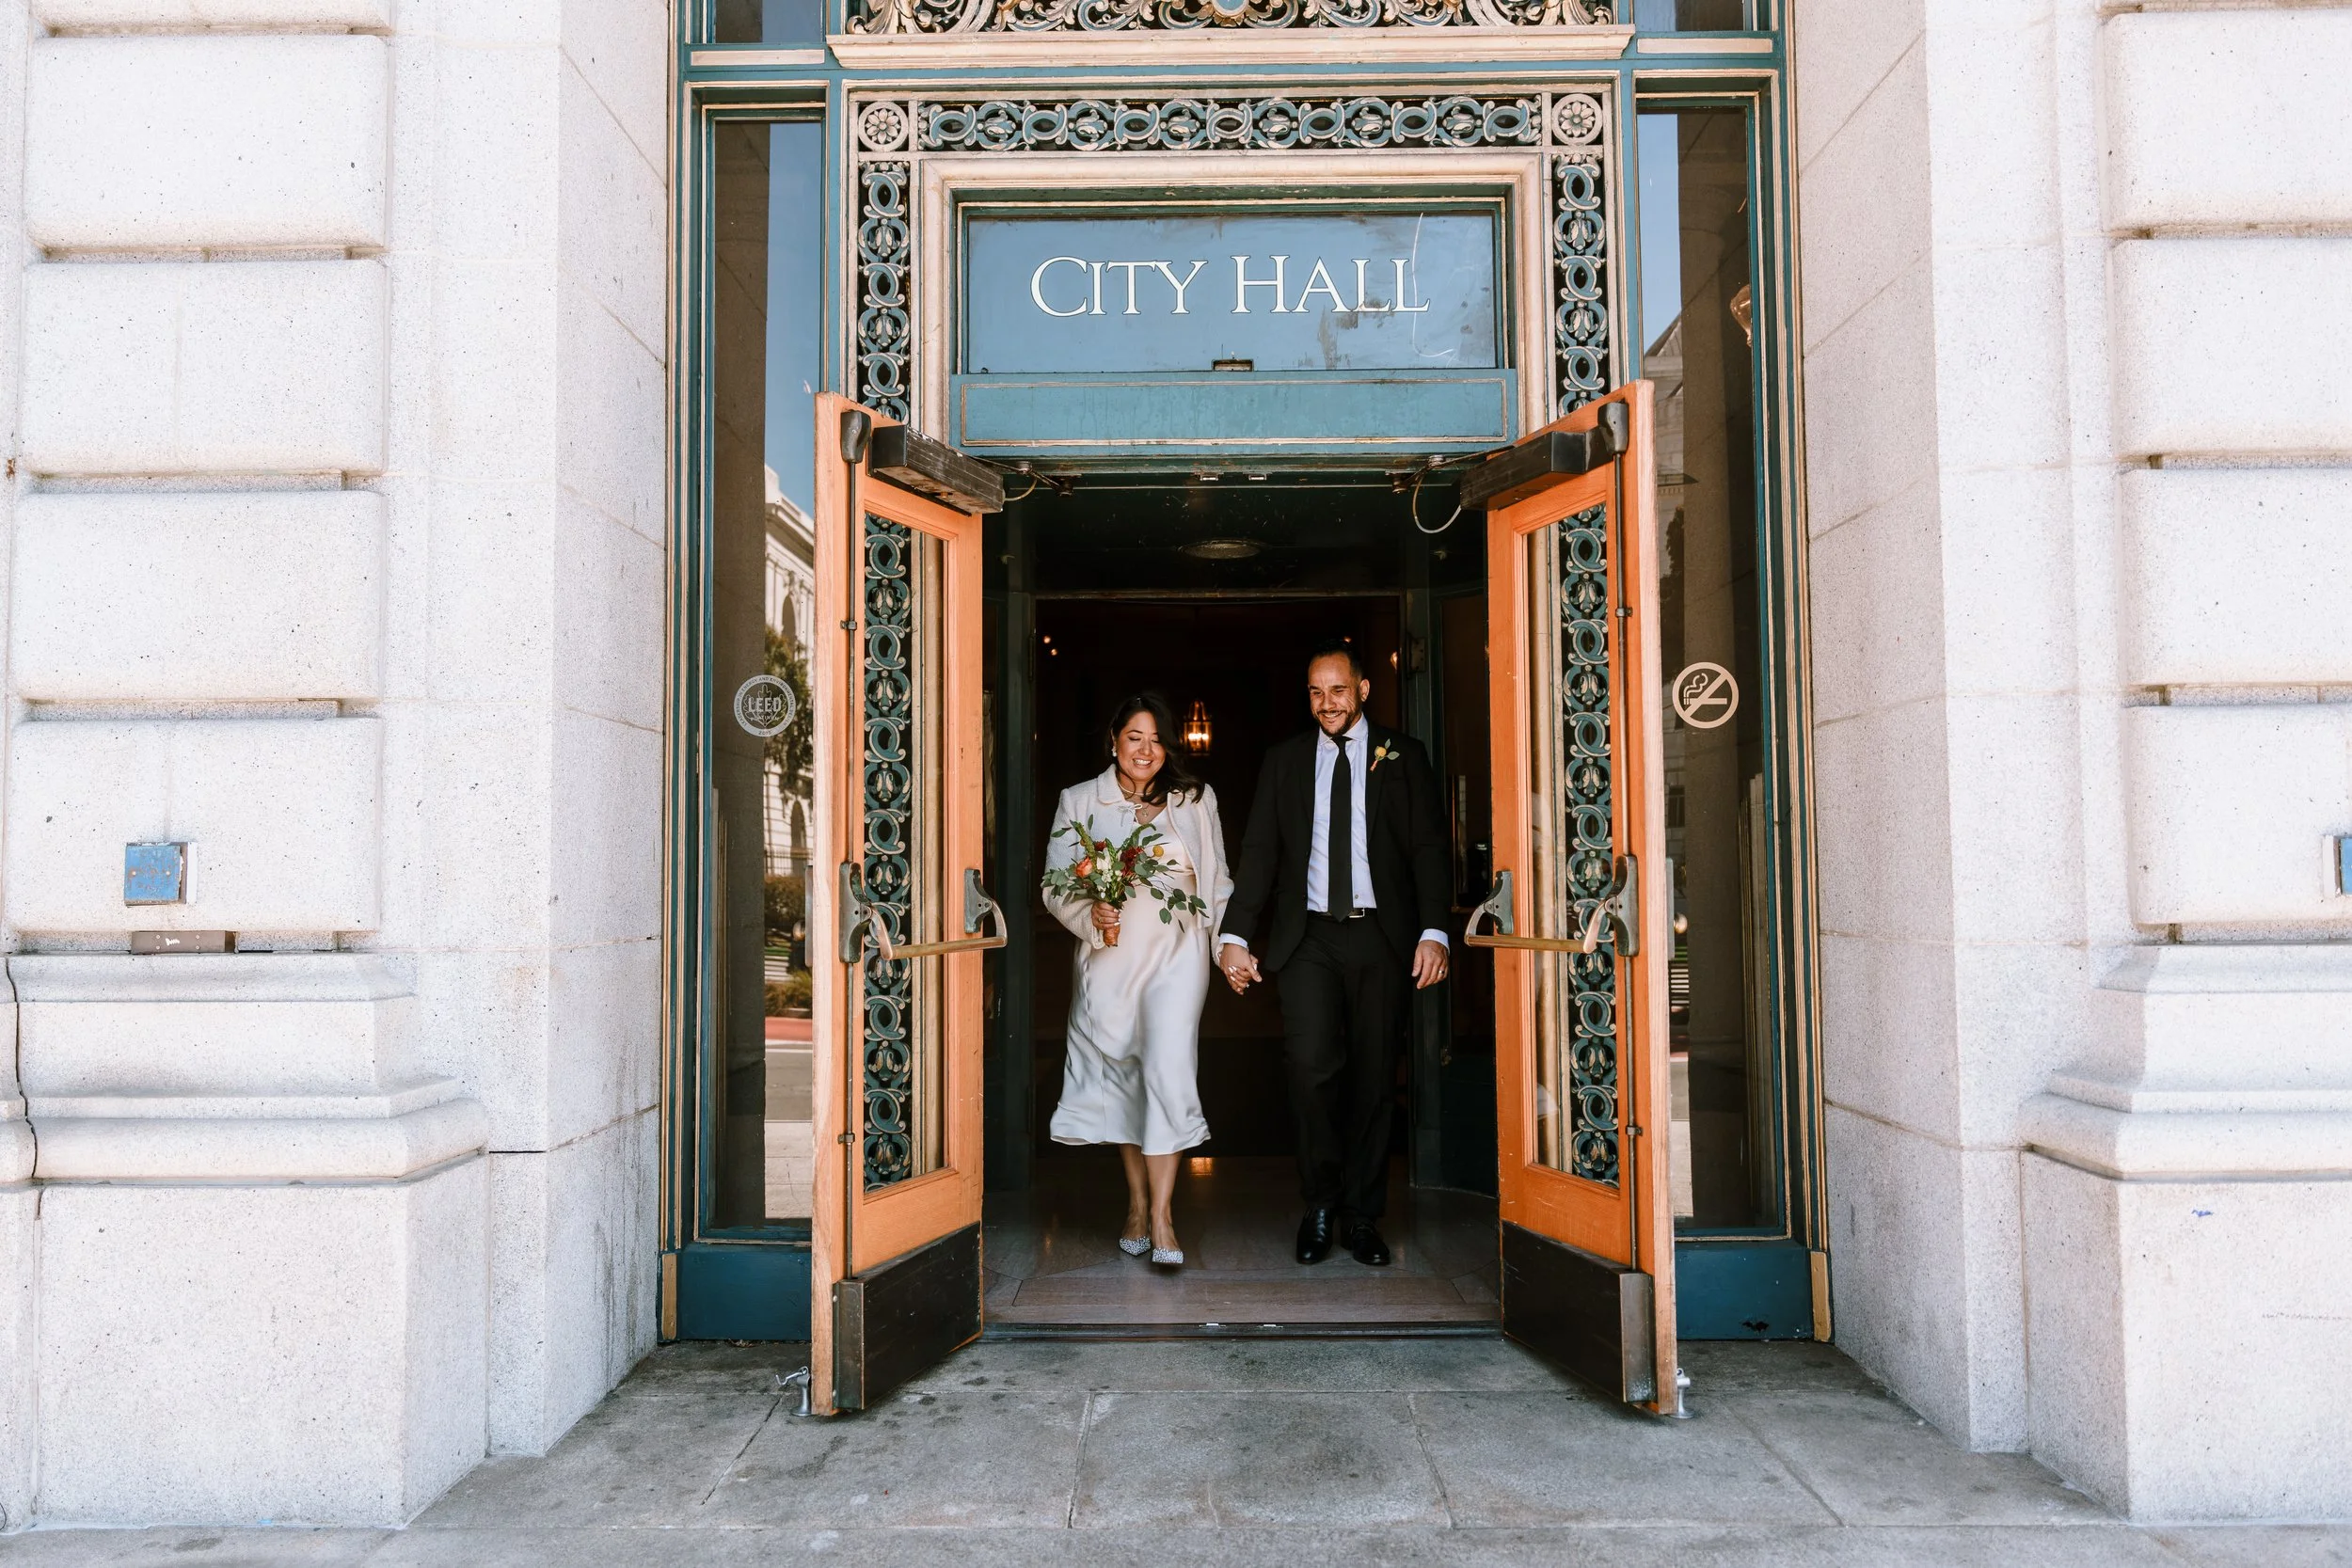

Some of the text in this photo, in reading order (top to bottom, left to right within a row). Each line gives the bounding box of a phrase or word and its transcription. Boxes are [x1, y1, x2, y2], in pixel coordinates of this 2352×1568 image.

[1030, 255, 1430, 317] CITY HALL
[741, 679, 757, 691] ENERGY
[736, 698, 747, 726] LEADERSHIP
[748, 697, 782, 712] LEED
